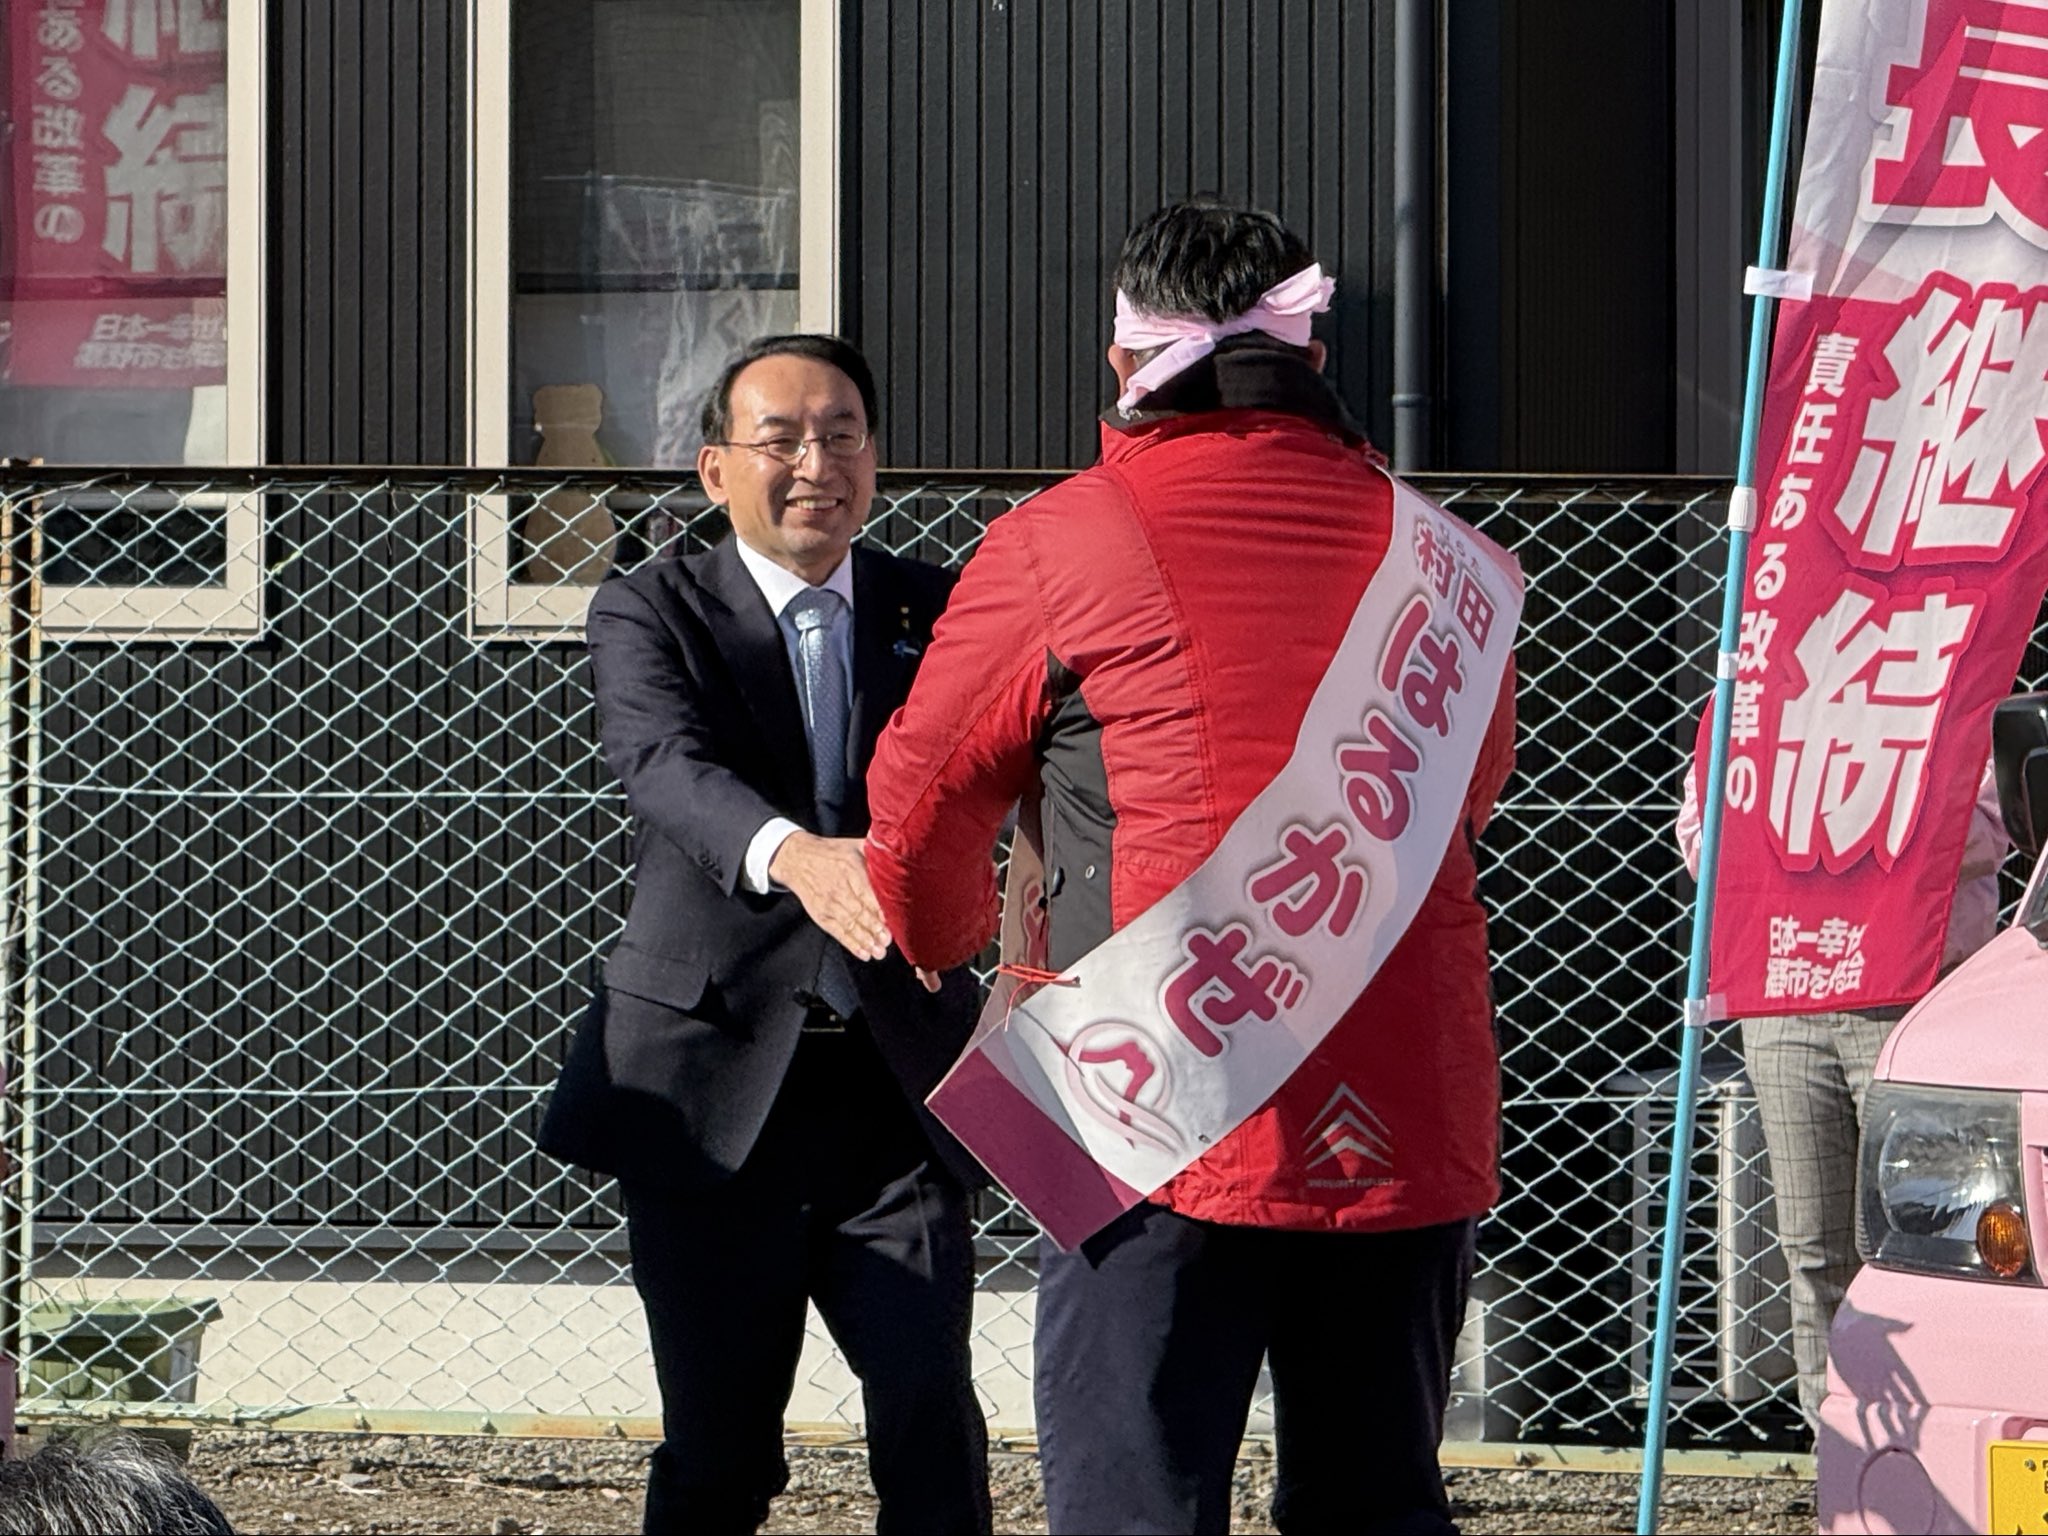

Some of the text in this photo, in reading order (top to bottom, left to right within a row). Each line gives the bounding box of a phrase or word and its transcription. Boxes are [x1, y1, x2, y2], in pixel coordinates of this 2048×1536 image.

[1417, 526, 1495, 654] 村田
[1725, 332, 1860, 815] 責任ある改革の
[1164, 599, 1463, 1058] はるかぜ
